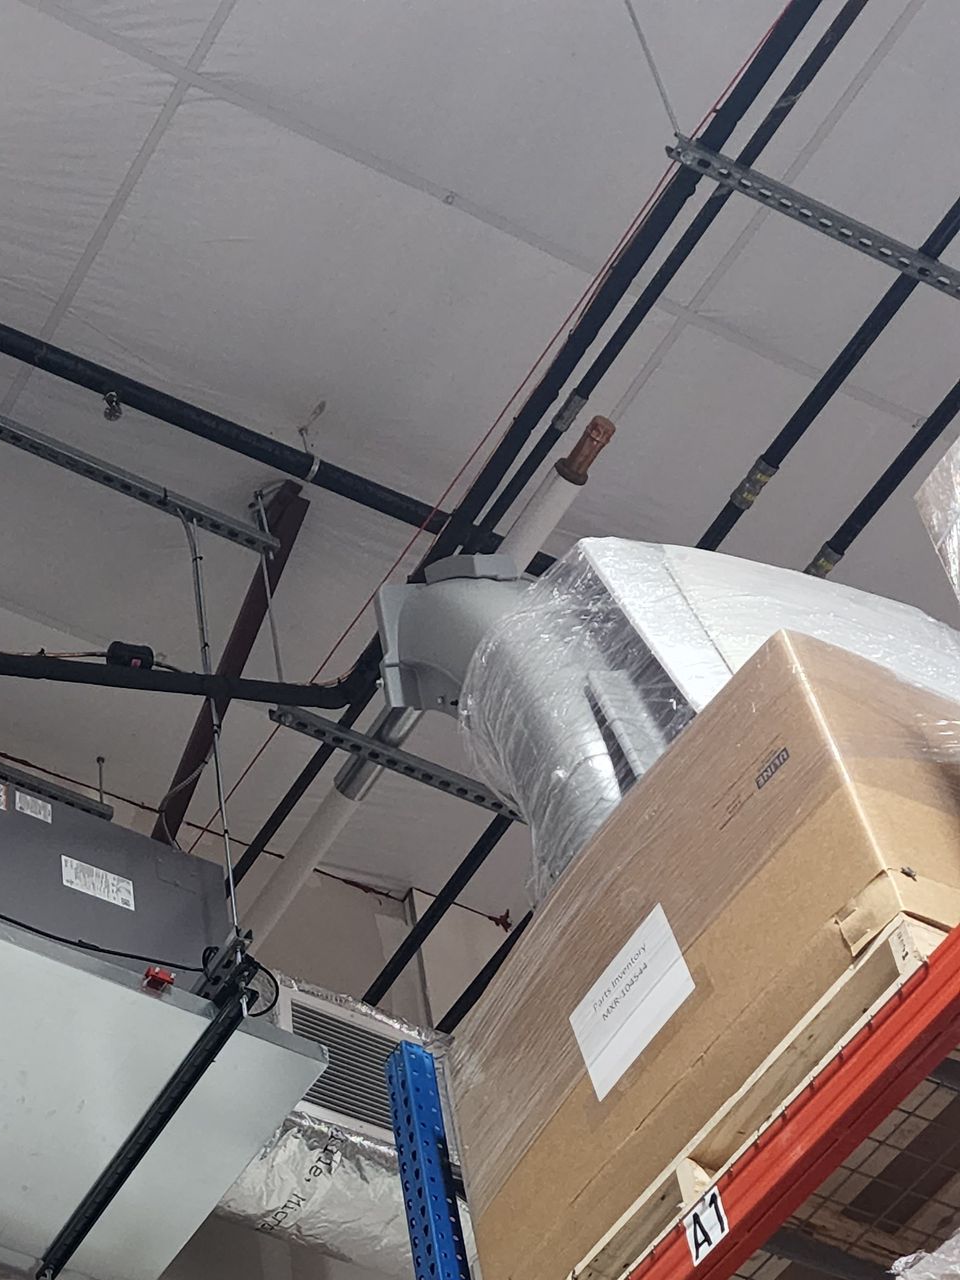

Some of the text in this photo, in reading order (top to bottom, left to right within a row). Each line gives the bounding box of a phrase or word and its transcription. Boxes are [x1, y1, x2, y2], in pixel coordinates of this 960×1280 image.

[755, 748, 789, 789] ULINE
[593, 943, 646, 1013] Parts Inventory
[602, 962, 648, 1023] MXR-104544
[692, 1191, 725, 1261] A1
